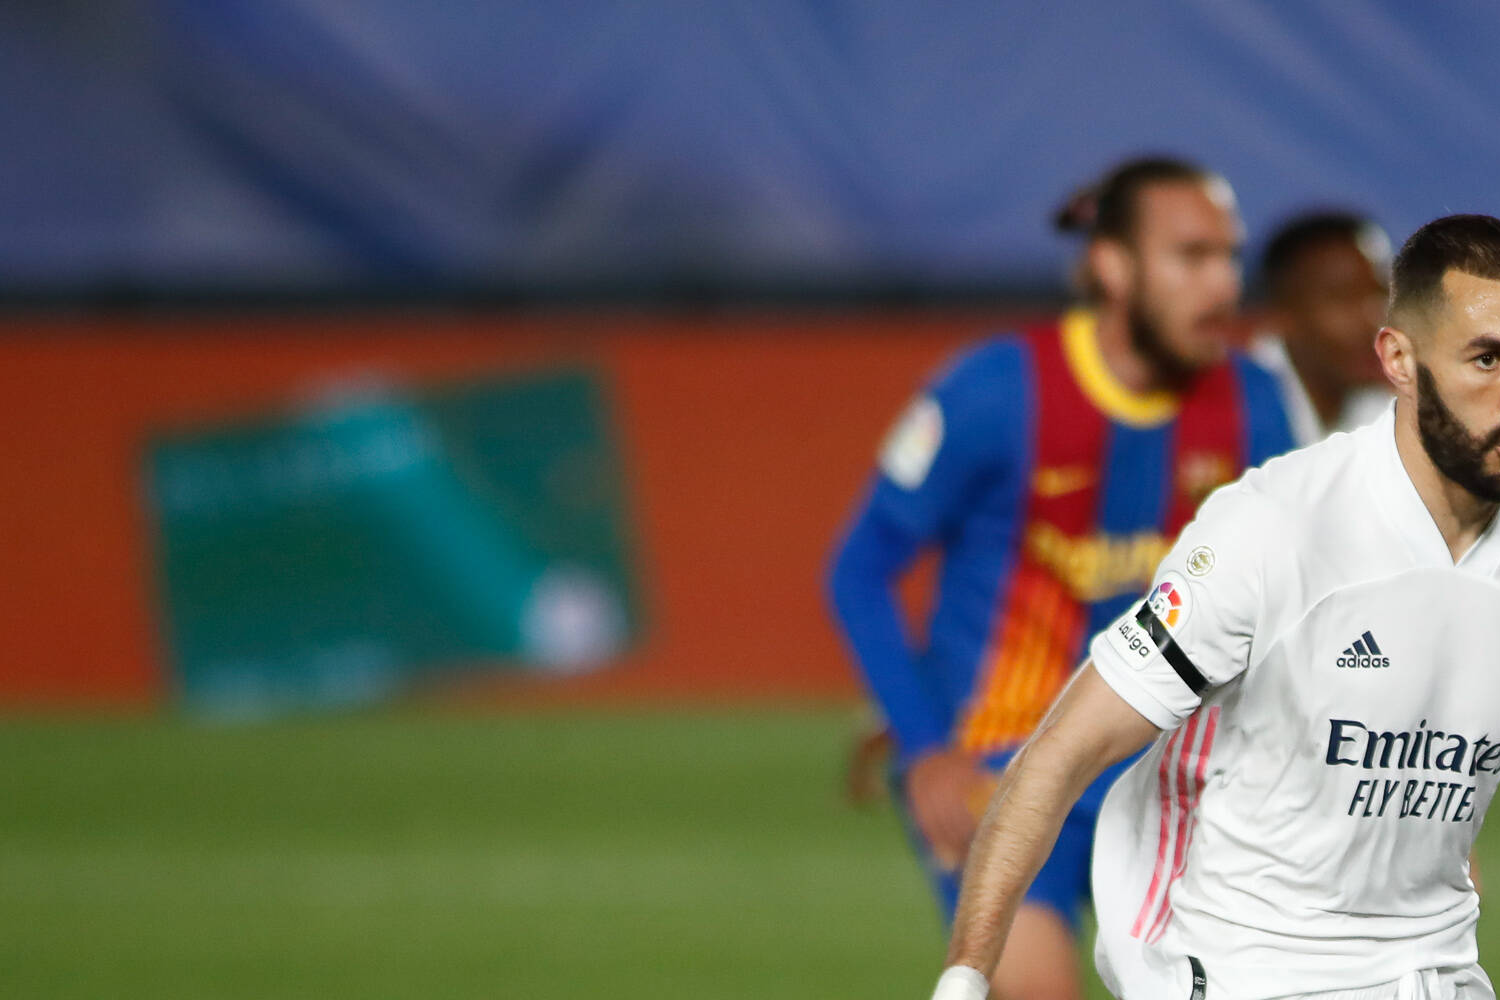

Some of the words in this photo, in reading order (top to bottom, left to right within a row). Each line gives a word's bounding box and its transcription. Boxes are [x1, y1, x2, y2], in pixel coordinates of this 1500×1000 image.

[1118, 620, 1150, 658] LaLiga
[1336, 654, 1390, 668] adidas
[1347, 779, 1400, 818] FLY
